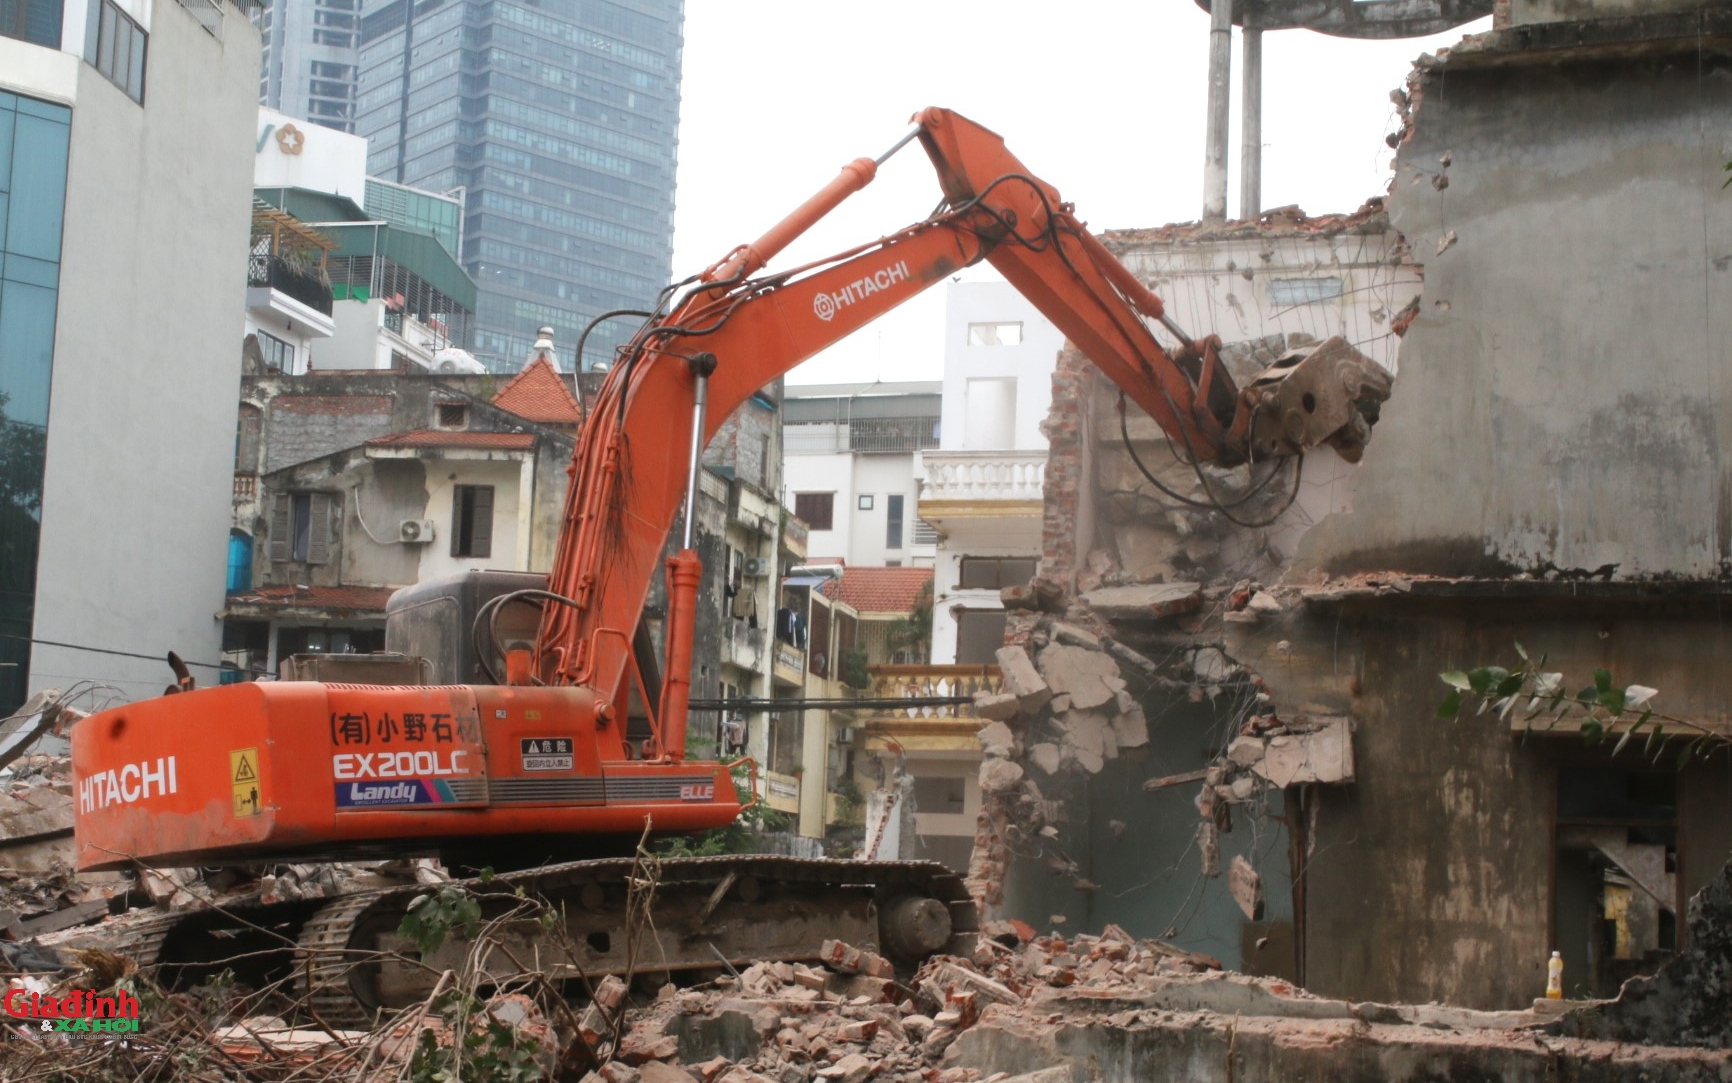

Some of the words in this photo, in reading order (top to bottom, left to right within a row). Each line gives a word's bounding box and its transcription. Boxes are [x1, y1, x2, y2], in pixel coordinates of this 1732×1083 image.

[832, 260, 910, 310] HITACHI
[333, 750, 469, 779] EX200LC
[79, 755, 177, 815] HITACHI
[350, 782, 417, 803] Landy
[680, 785, 714, 800] ELLE
